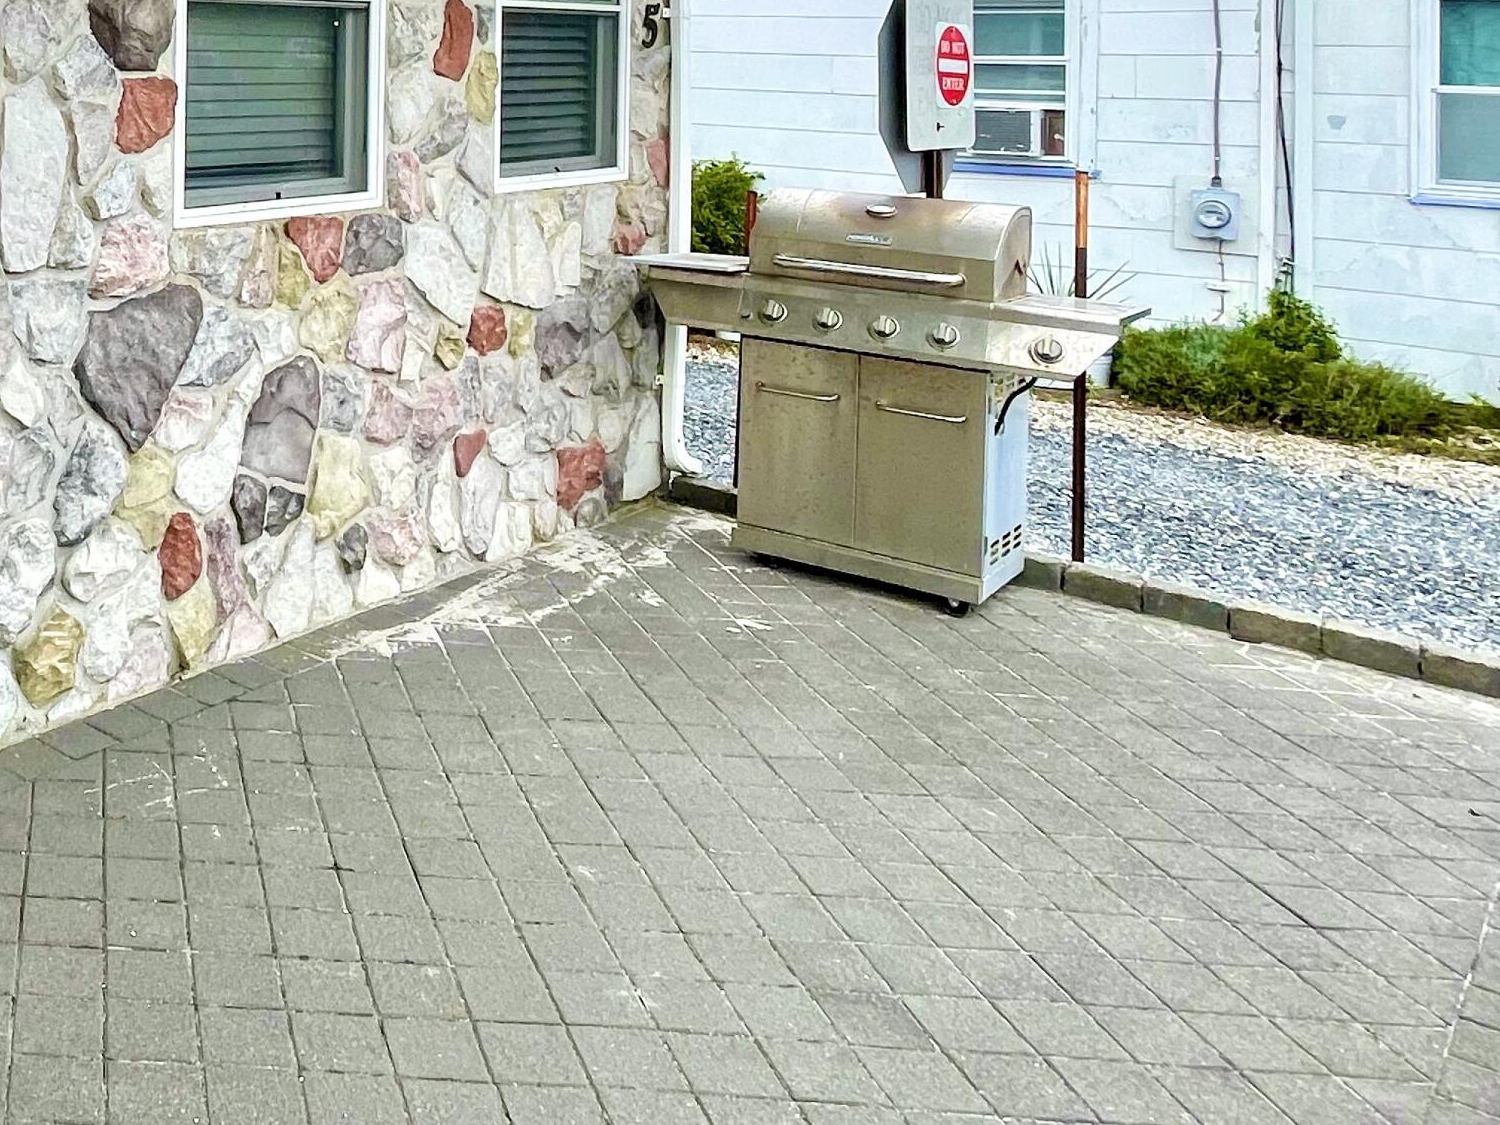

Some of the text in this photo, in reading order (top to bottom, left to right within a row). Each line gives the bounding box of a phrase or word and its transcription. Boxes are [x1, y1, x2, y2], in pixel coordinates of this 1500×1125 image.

[940, 40, 965, 54] DO NOT
[942, 76, 965, 91] ENTER
